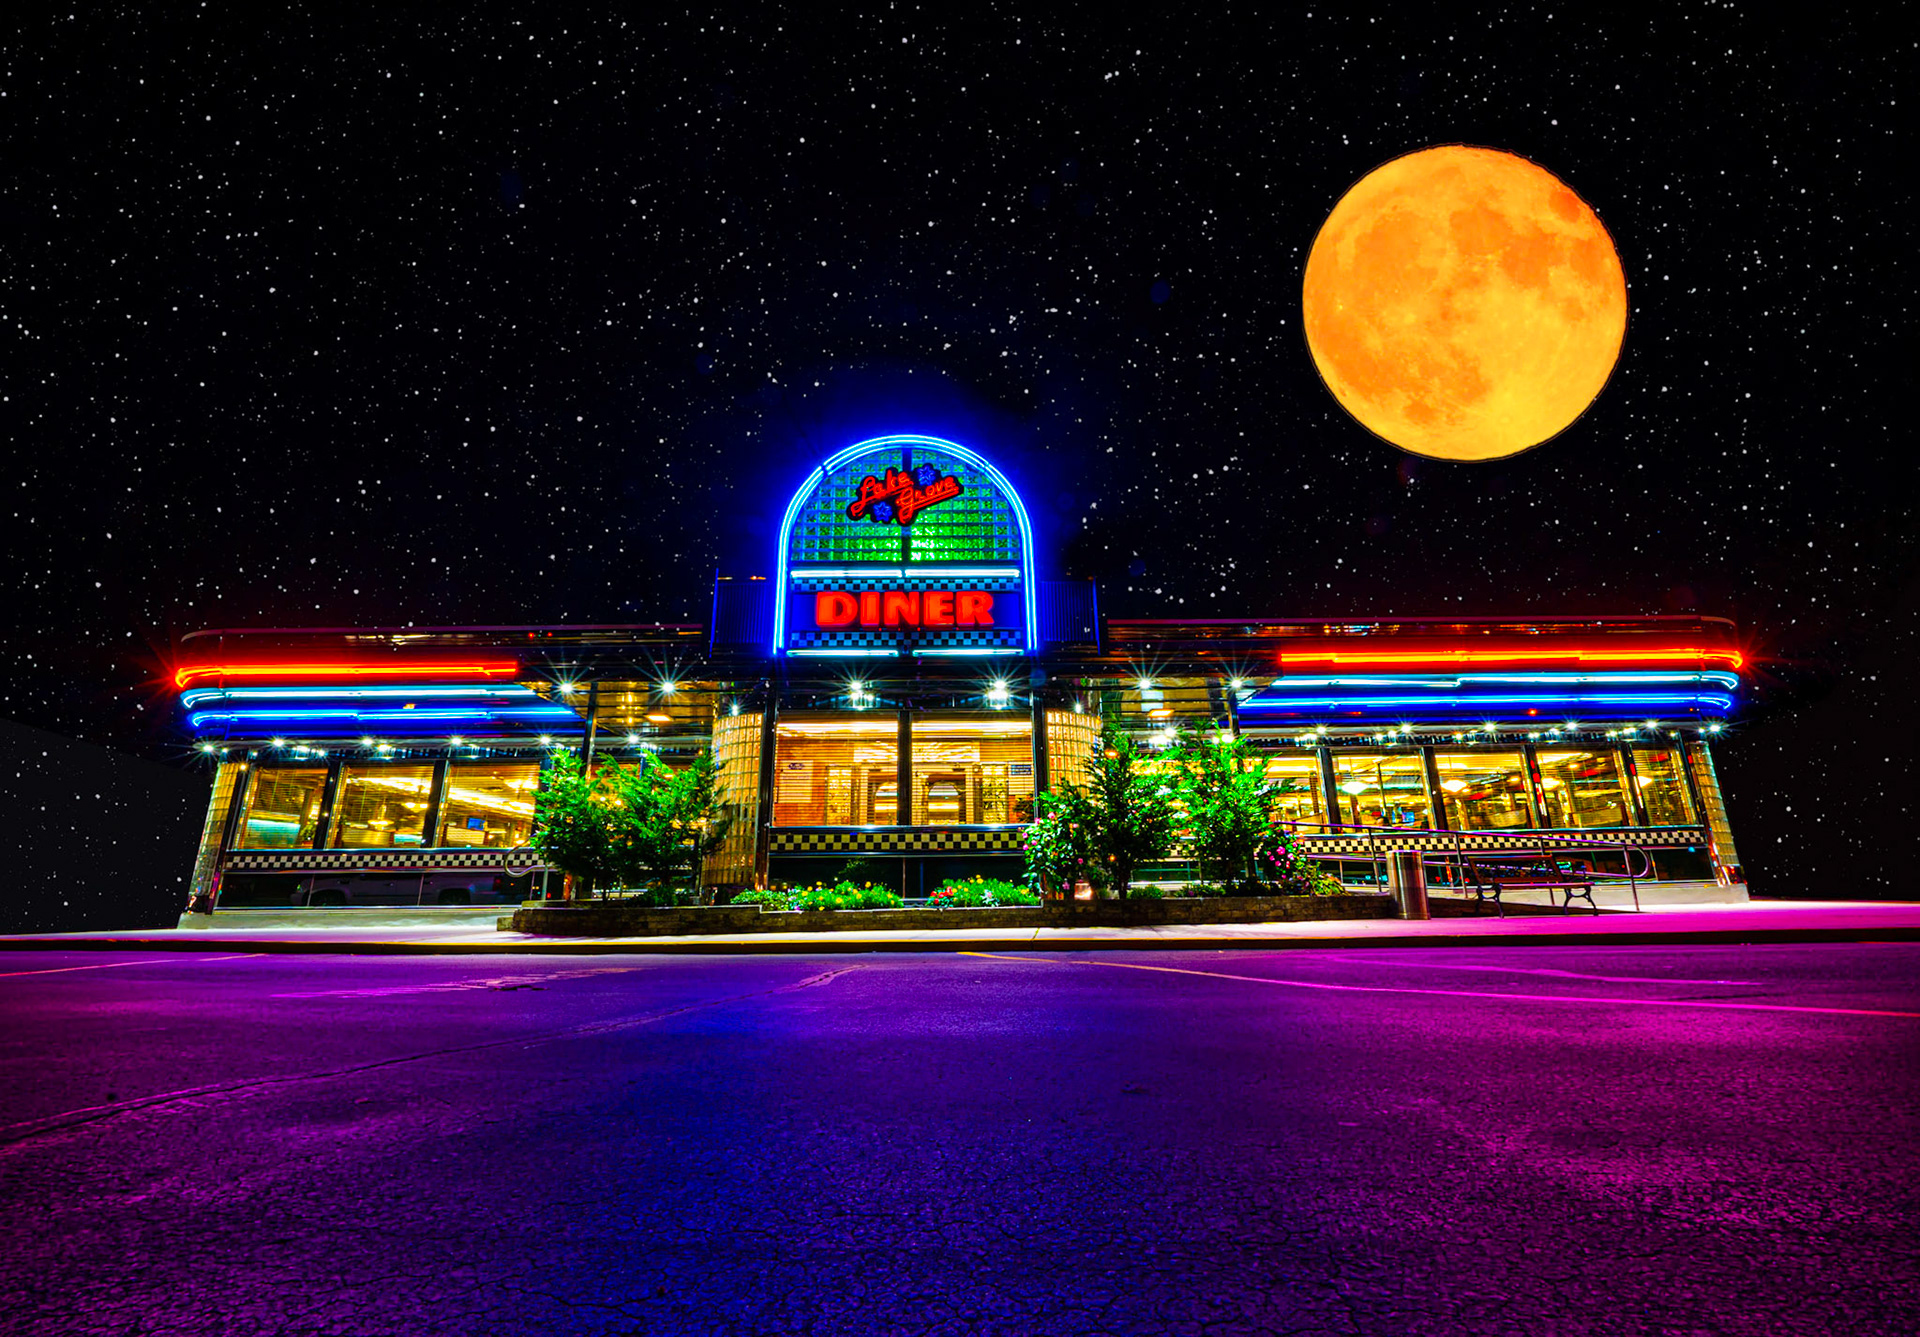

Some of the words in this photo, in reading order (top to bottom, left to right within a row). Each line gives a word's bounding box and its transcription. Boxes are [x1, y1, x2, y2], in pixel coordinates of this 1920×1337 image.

[850, 469, 914, 517] Lake
[895, 476, 960, 524] Grove
[816, 591, 994, 625] DINER
